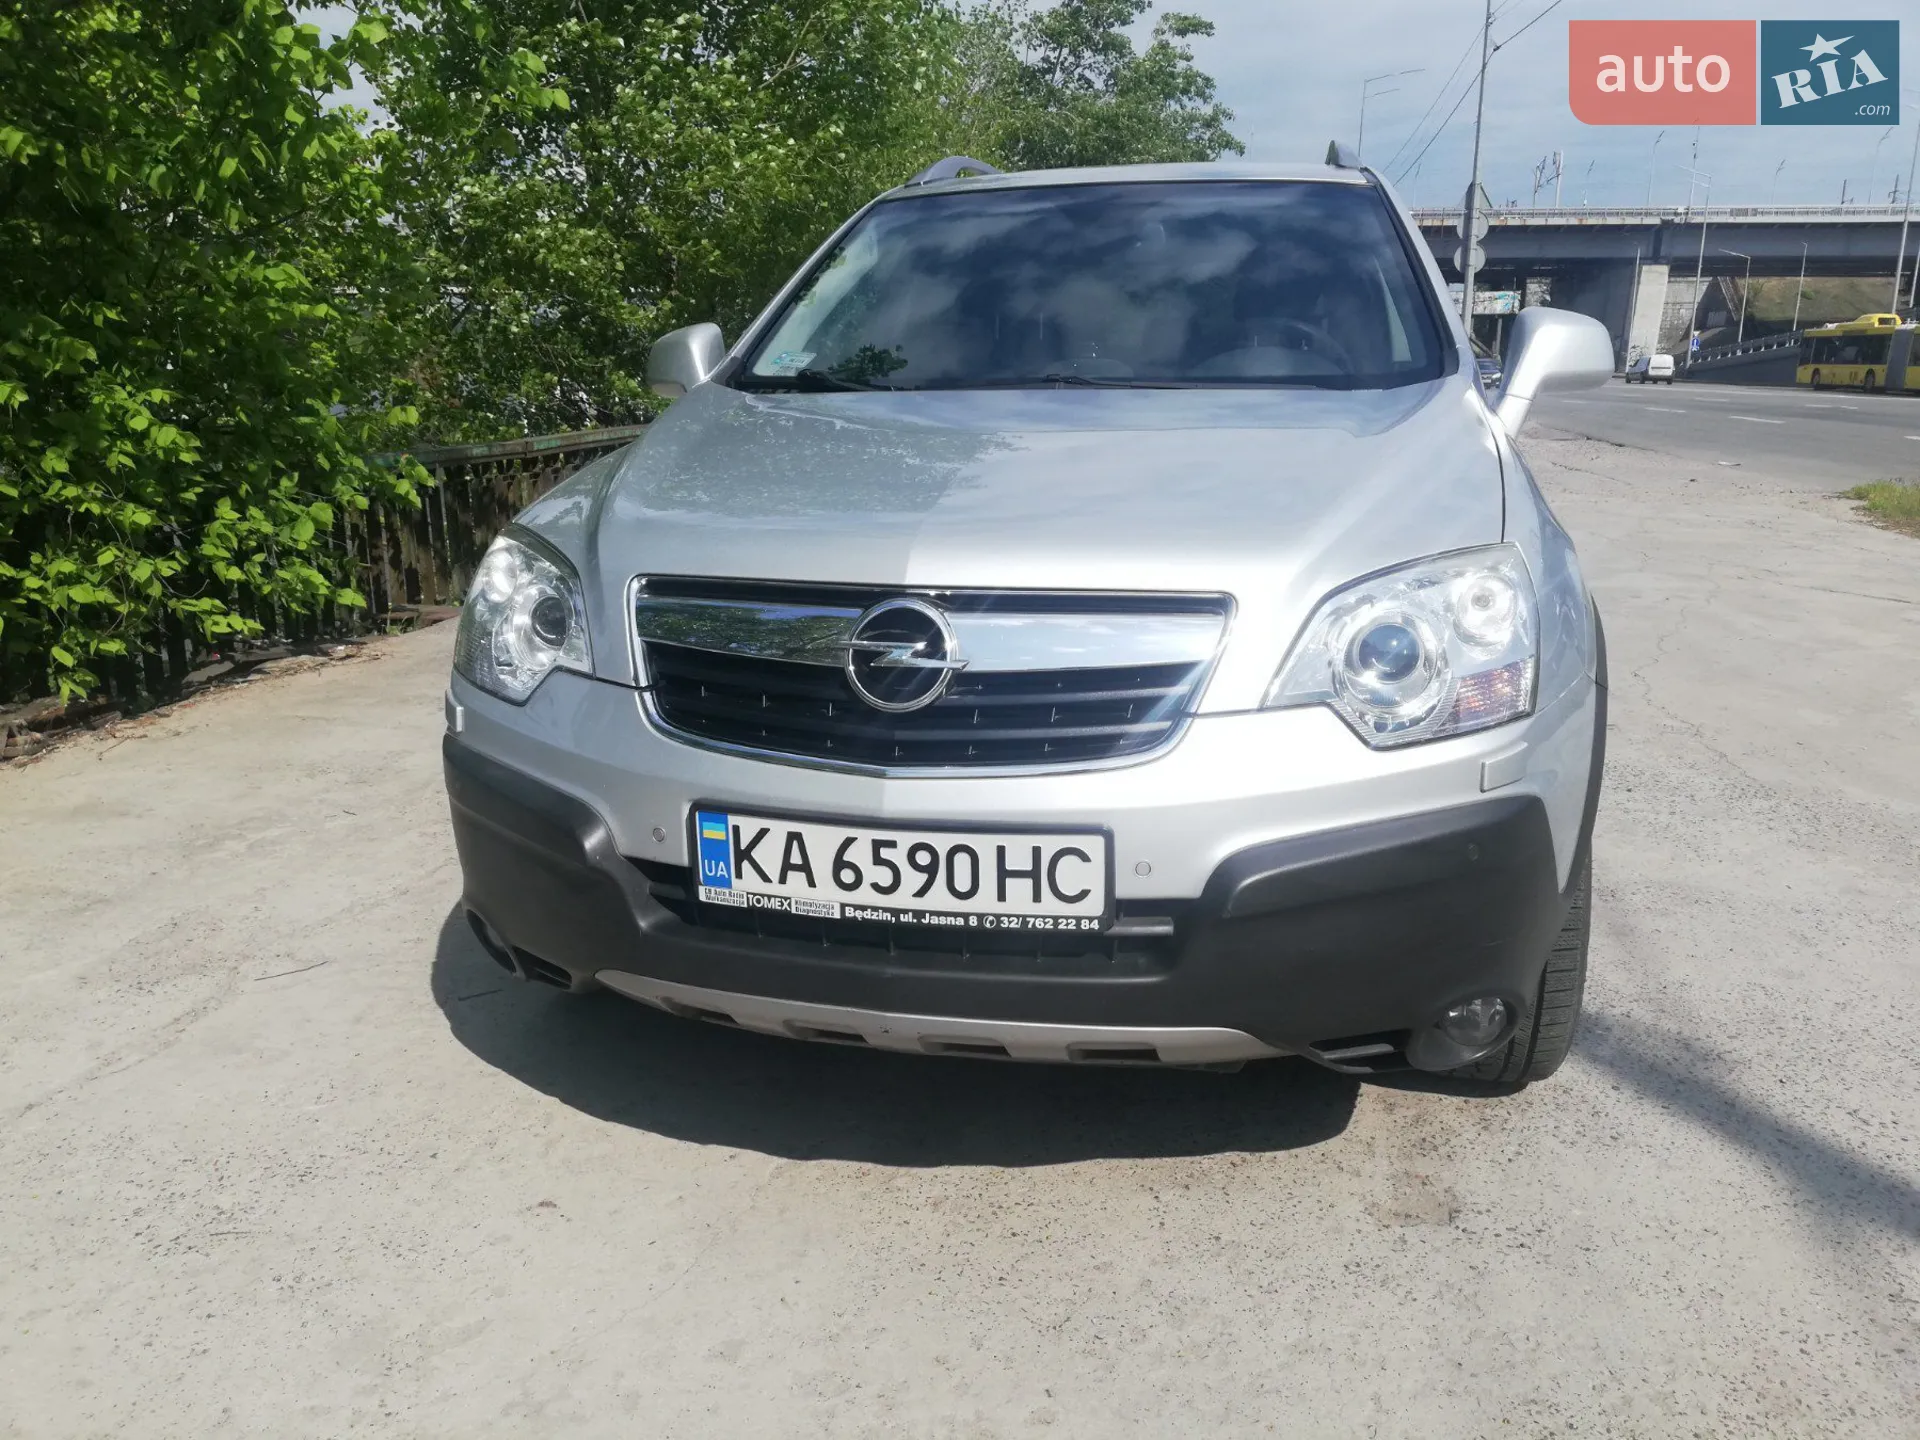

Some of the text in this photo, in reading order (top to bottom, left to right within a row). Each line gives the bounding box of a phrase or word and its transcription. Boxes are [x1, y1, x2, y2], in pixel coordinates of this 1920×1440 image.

[704, 859, 729, 879] UA
[732, 824, 1092, 904] KA 6590 HC
[747, 894, 791, 911] TOMEX
[794, 899, 835, 910] Klimatyzacja
[795, 906, 835, 917] Diagnostyka
[845, 906, 896, 923] Będzin,
[900, 912, 917, 923] ul.
[921, 913, 965, 926] Jasna
[968, 915, 978, 926] 8
[1026, 917, 1054, 929] 762
[1057, 918, 1077, 930] 22
[1080, 919, 1100, 931] 84
